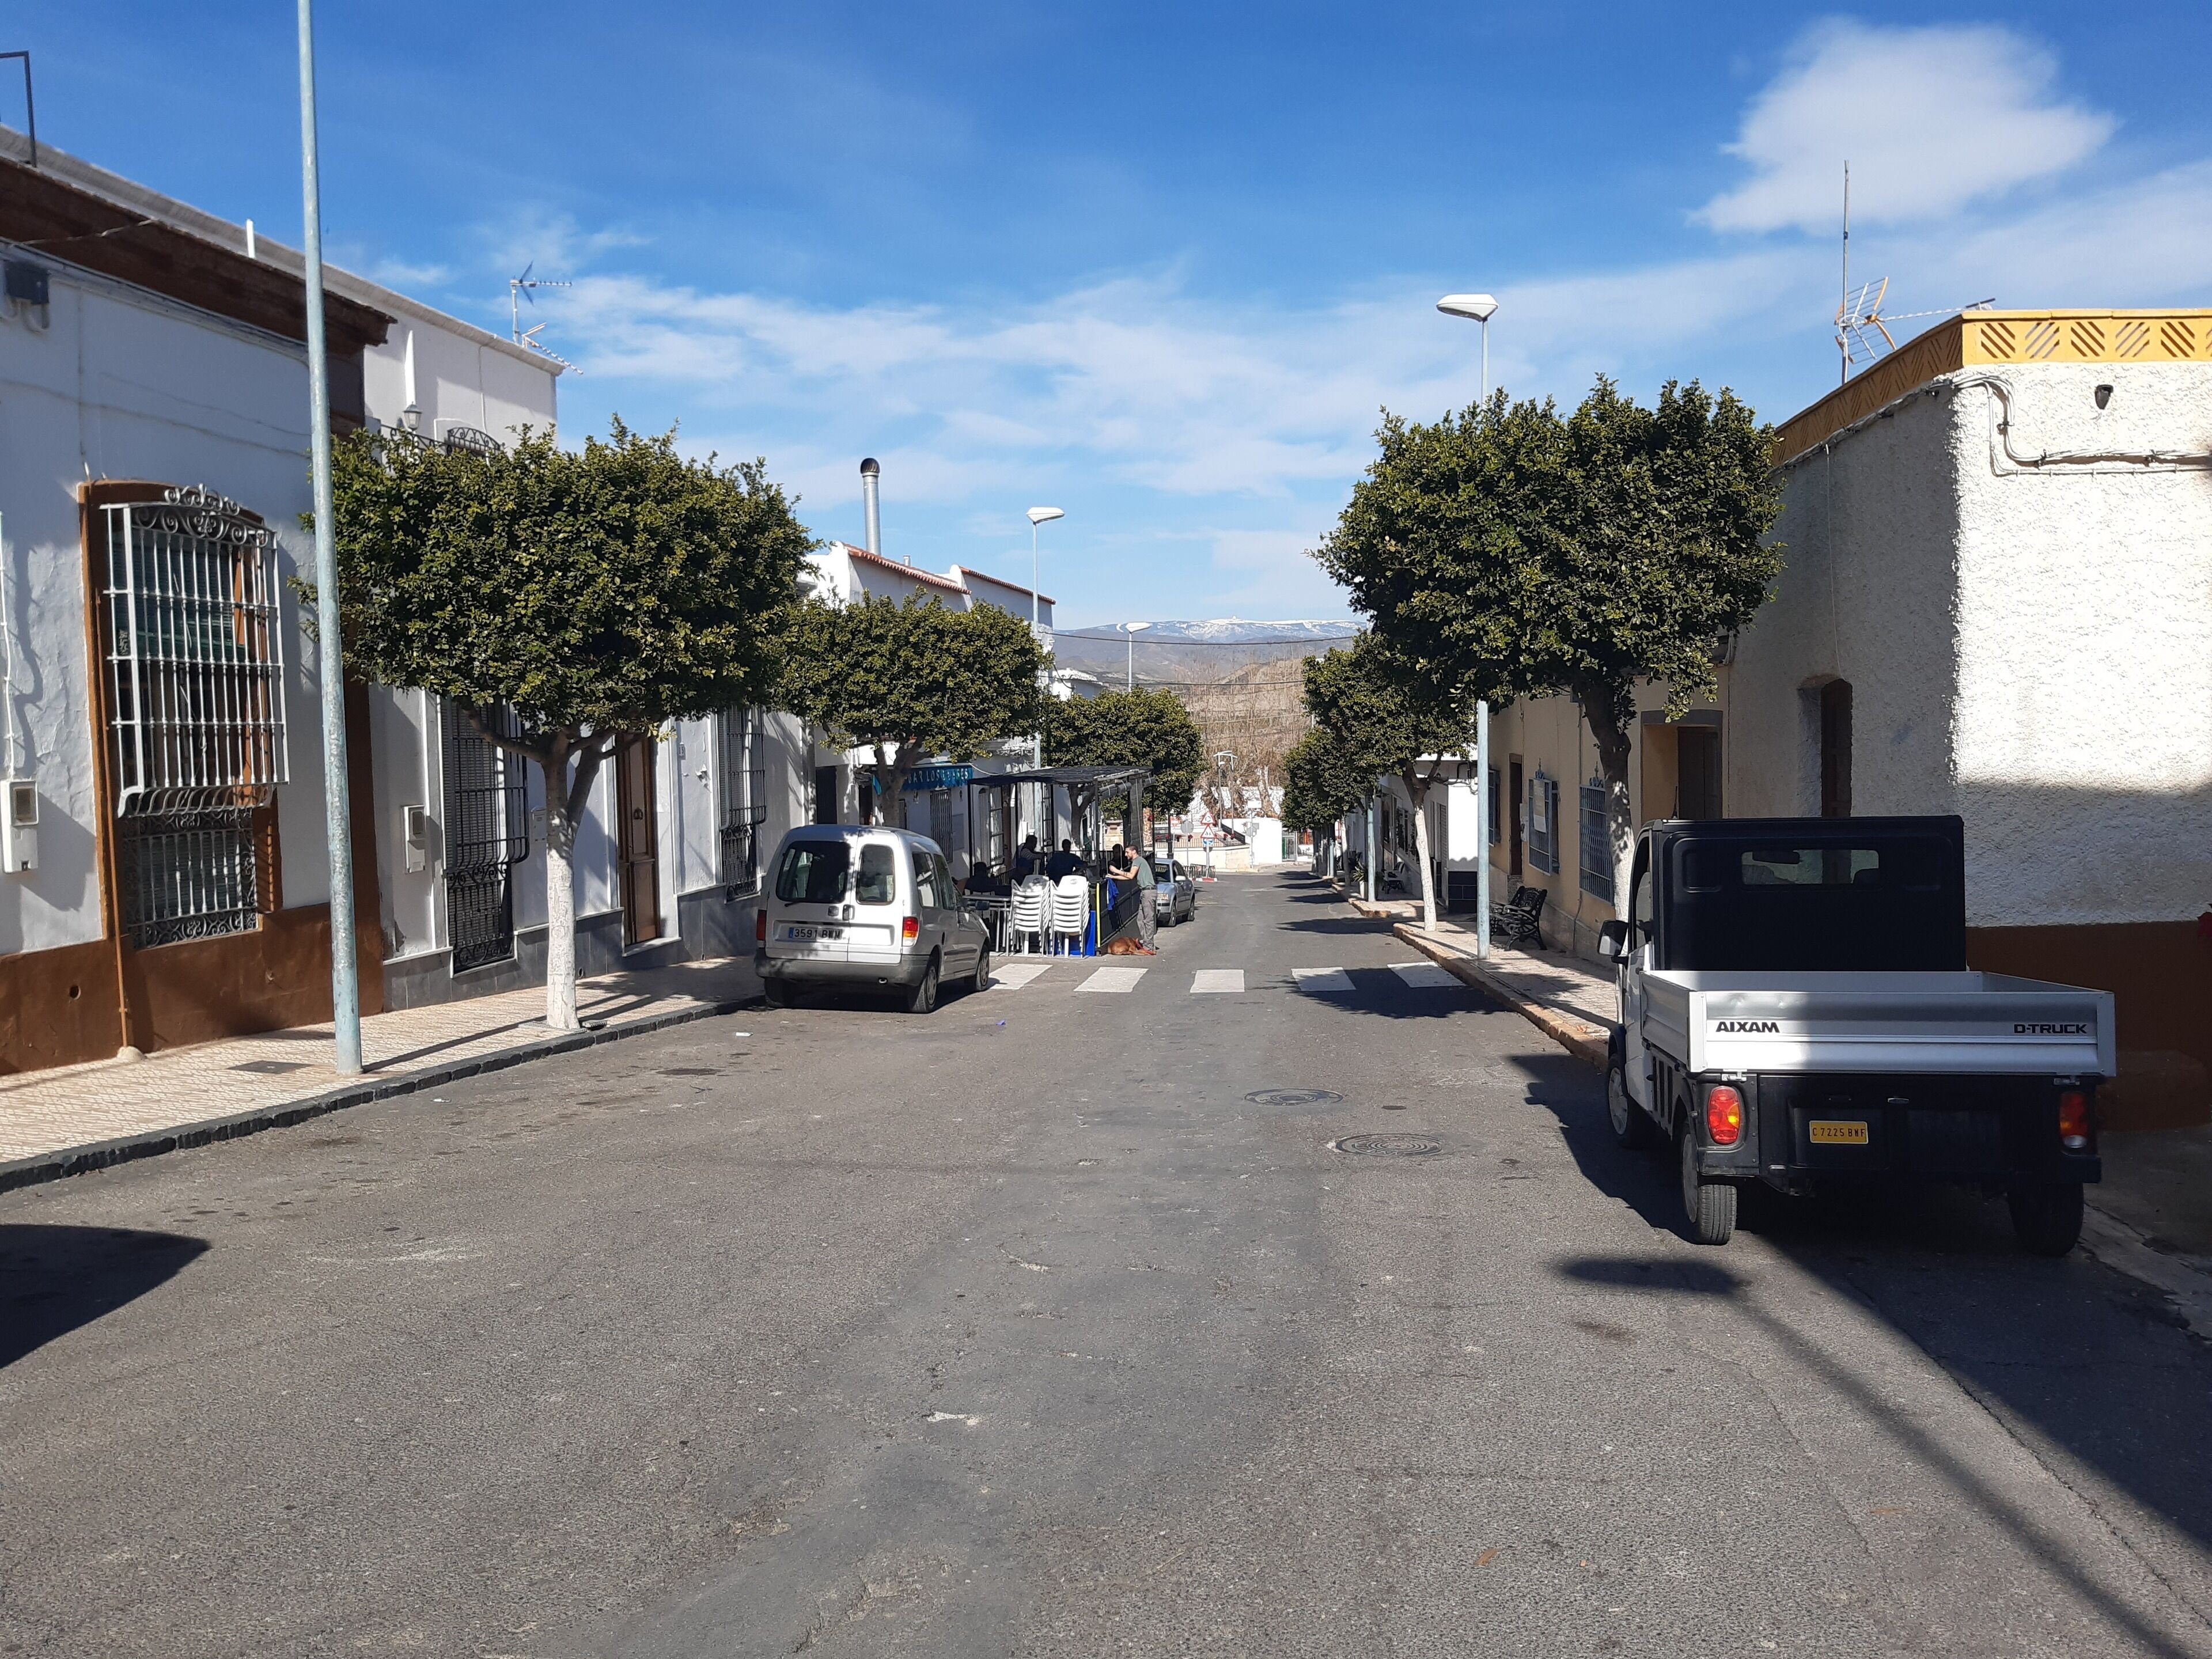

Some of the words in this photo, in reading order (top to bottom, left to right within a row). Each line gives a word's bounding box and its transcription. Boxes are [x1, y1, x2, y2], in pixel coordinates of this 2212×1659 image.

[926, 770, 940, 782] LOS
[794, 929, 818, 938] 3591
[821, 930, 840, 940] BWM
[1715, 1021, 1781, 1033] AIXAM
[2014, 1024, 2087, 1034] D-TRUCK
[1812, 1127, 1817, 1137] C
[1820, 1127, 1845, 1137] 7225
